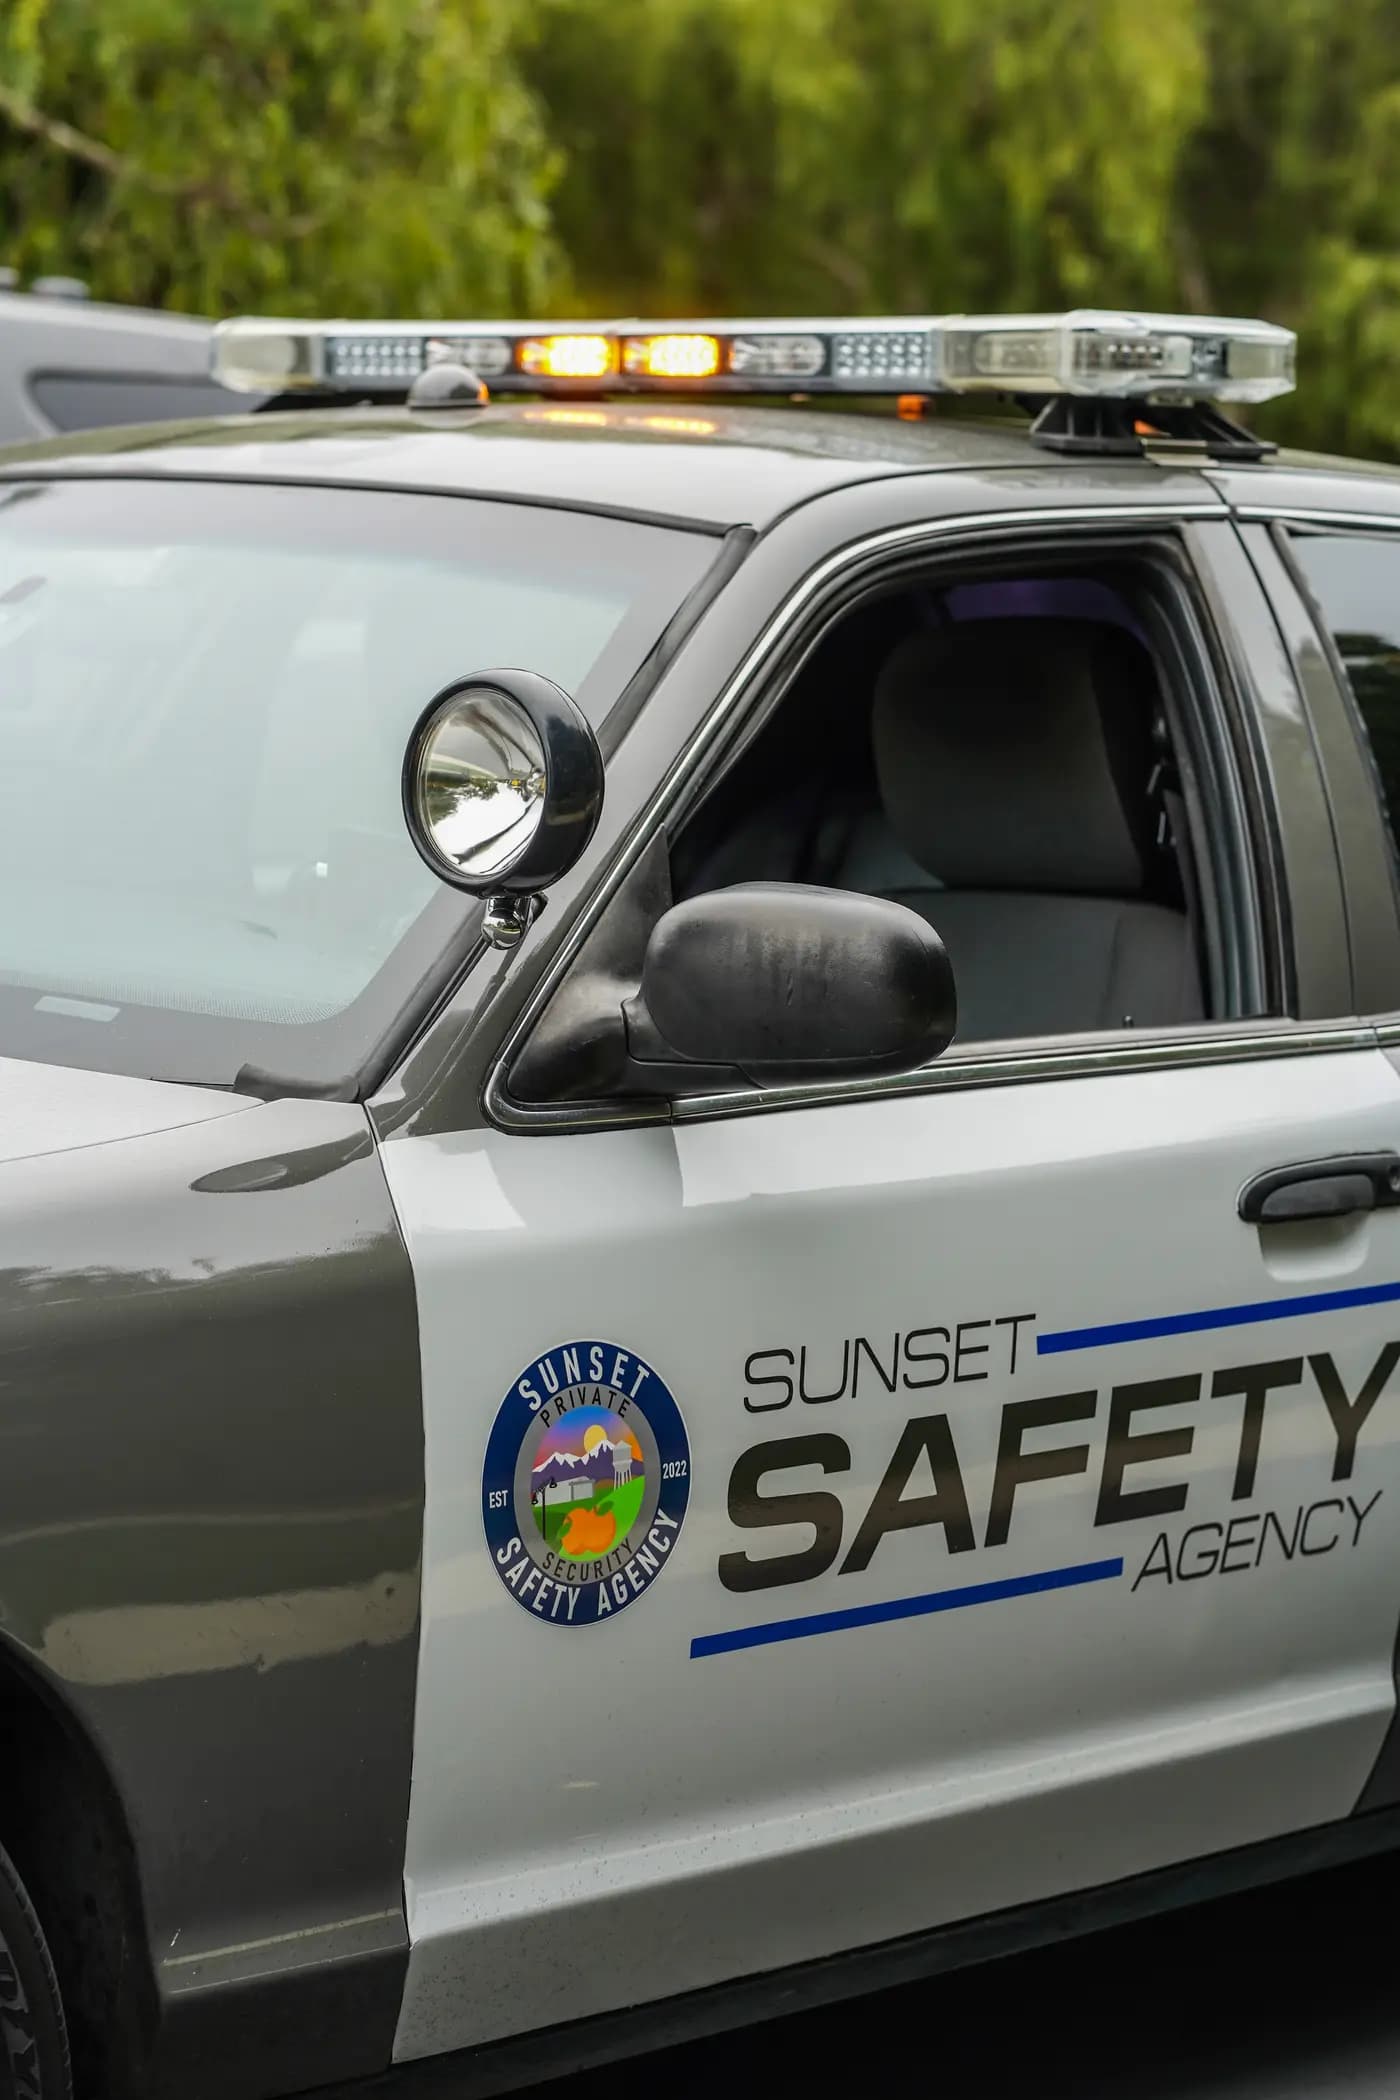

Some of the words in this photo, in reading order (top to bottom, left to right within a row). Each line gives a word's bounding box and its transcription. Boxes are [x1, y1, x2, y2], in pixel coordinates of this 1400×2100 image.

[518, 1346, 650, 1411] SUNSET
[743, 1313, 1036, 1414] SUNSET
[540, 1386, 631, 1428] PRIVATE
[489, 1490, 508, 1509] EST
[662, 1460, 687, 1480] 2022
[717, 1341, 1400, 1594] SAFETY
[496, 1536, 581, 1620] SAFETY
[597, 1508, 679, 1616] AGENCY
[542, 1538, 634, 1581] SECURITY
[1131, 1490, 1383, 1593] AGENCY
